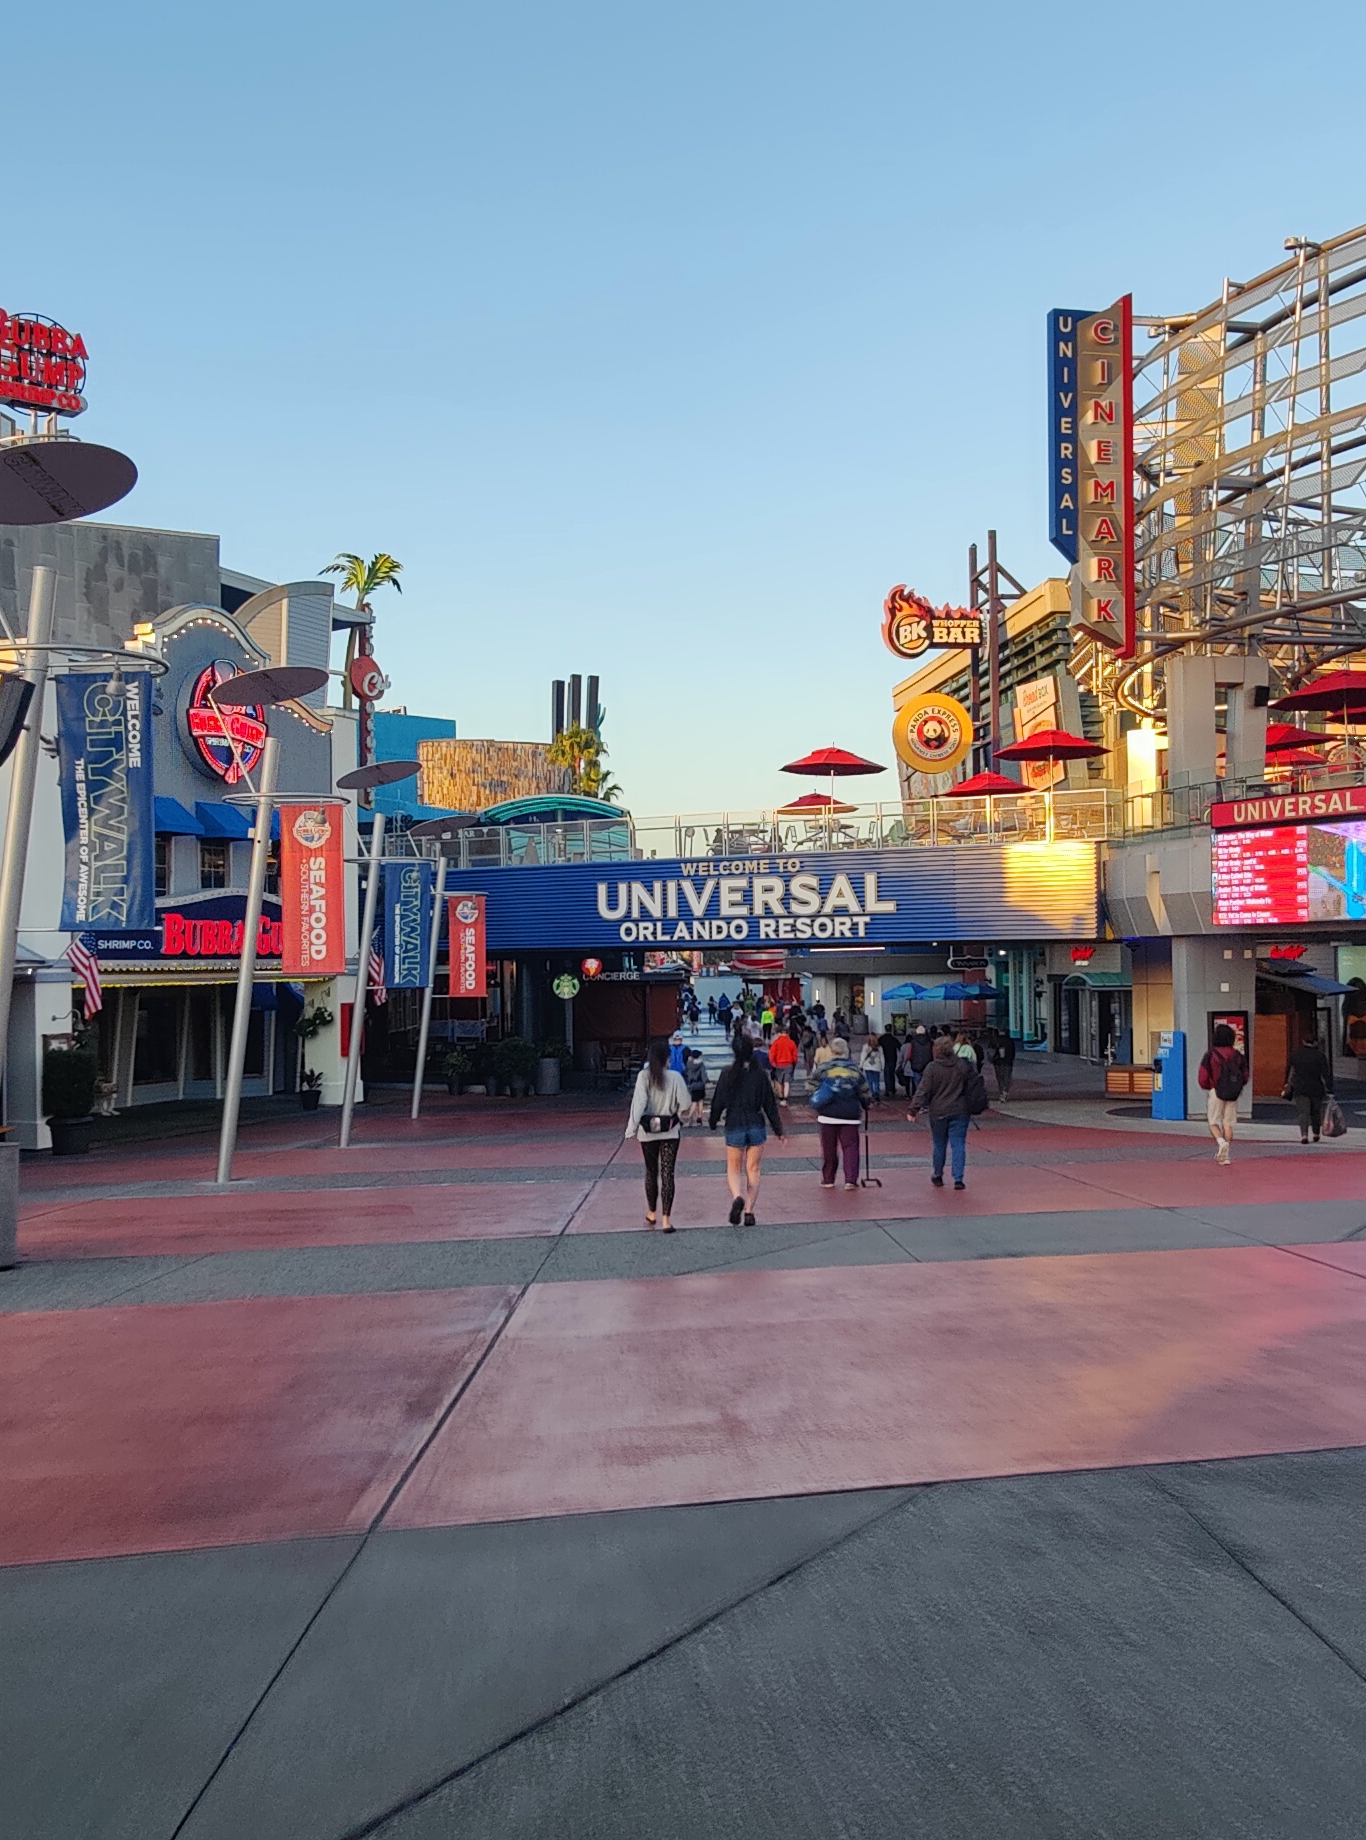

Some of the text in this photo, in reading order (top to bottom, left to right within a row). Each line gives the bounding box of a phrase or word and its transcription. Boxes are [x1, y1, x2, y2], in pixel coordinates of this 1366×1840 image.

[1059, 315, 1074, 536] UNIVERSAL
[1092, 319, 1117, 623] CINEMARK
[899, 619, 927, 646] BK
[932, 619, 980, 628] WHOPPER
[932, 627, 981, 643] BAR
[125, 681, 142, 769] WELCOME
[909, 707, 958, 734] PANDA EXPRESS
[74, 757, 85, 781] THE
[75, 780, 89, 843] EPICENTER
[84, 682, 128, 923] CITYWALK
[1233, 792, 1355, 823] UNIVERSAL
[77, 843, 89, 862] OF
[681, 858, 802, 876] WELCOME TO
[309, 856, 327, 961] SEAFOOD
[596, 872, 897, 920] UNIVERSAL
[300, 916, 310, 967] FAVORITES
[619, 916, 871, 942] ORLANDO RESORT
[97, 940, 137, 950] SHRIMP
[466, 927, 475, 990] SEAFOOD
